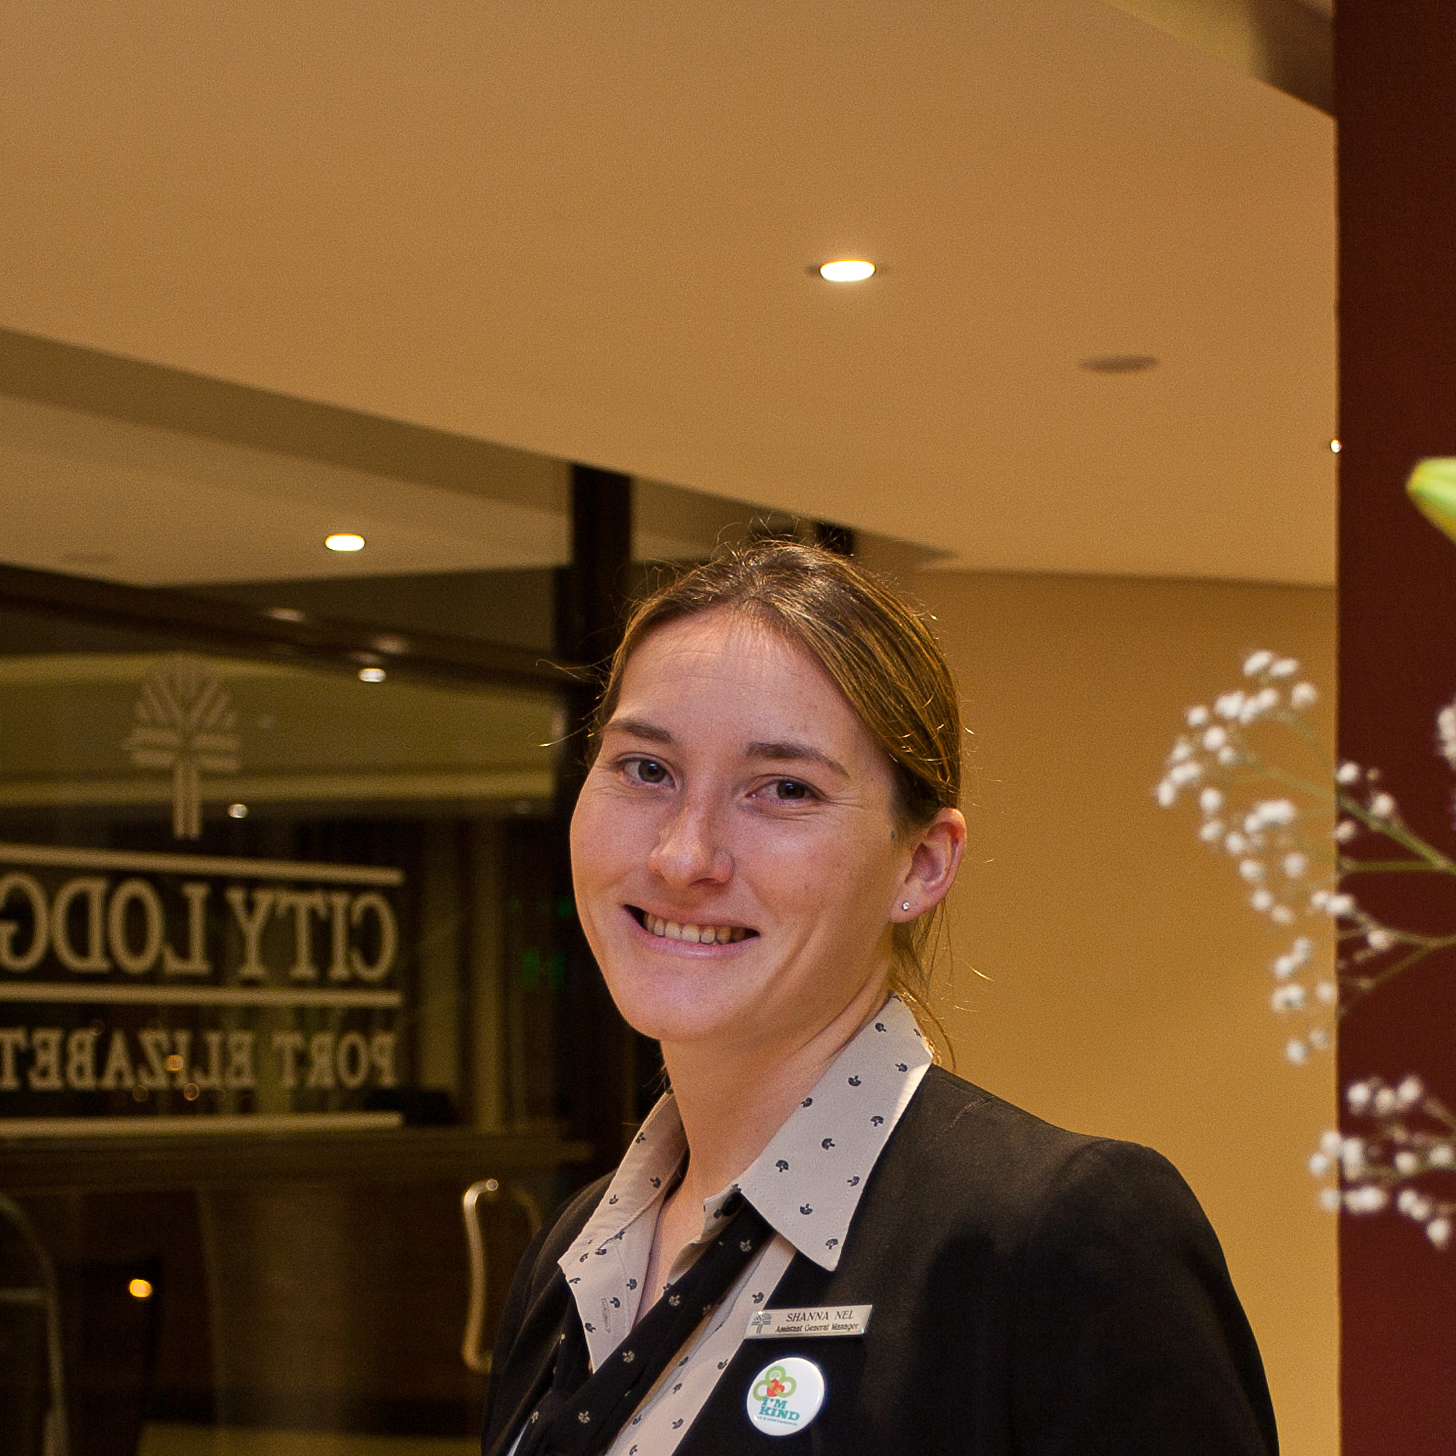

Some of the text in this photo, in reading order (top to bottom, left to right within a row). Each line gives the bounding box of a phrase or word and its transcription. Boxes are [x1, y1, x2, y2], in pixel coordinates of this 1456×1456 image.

[786, 1310, 854, 1322] SHANNA NEL
[762, 1396, 788, 1409] I'M
[759, 1405, 800, 1421] KIND
